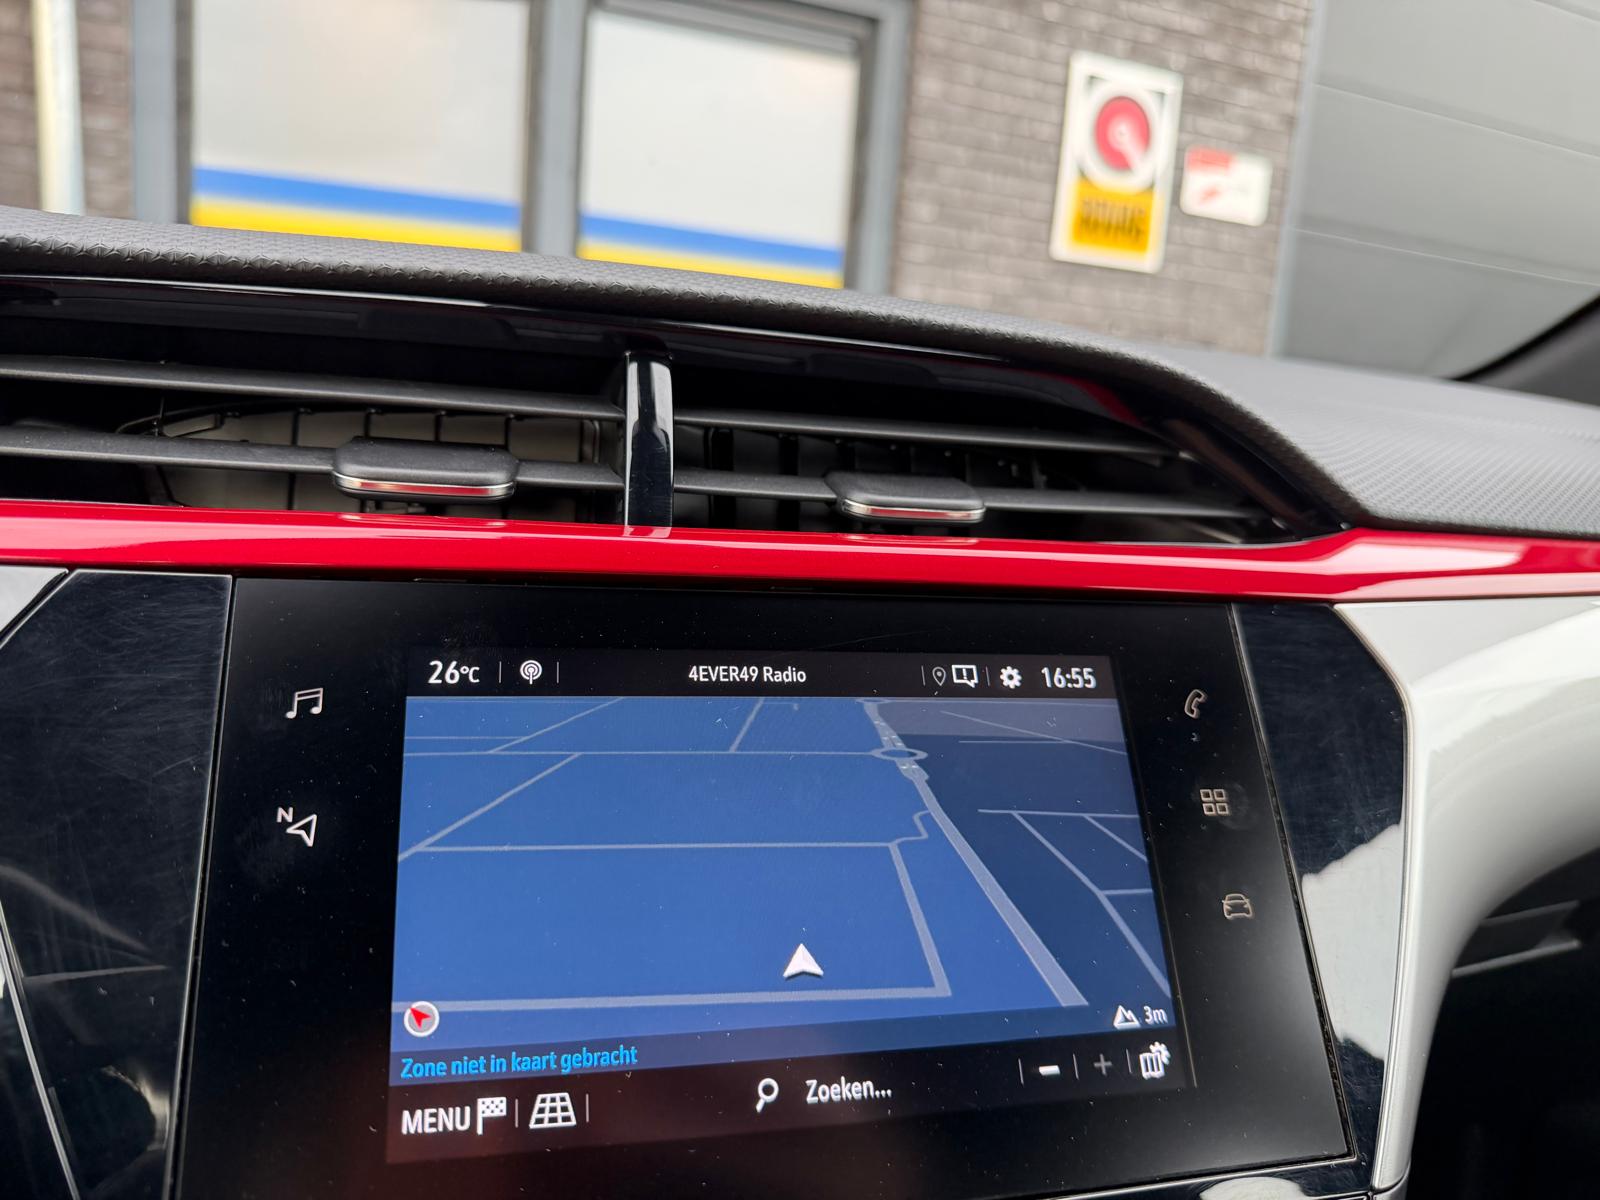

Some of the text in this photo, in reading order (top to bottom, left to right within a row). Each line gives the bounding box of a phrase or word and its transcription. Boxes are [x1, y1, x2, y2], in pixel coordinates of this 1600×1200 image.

[688, 664, 807, 683] 4EVER49 Radio
[1041, 666, 1096, 688] 16:55
[276, 806, 293, 823] N
[1143, 1005, 1168, 1025] 3m
[400, 1044, 638, 1079] Zone niet in kaart gebracht
[806, 1075, 893, 1104] Zoeken...
[401, 1105, 471, 1135] MENU
